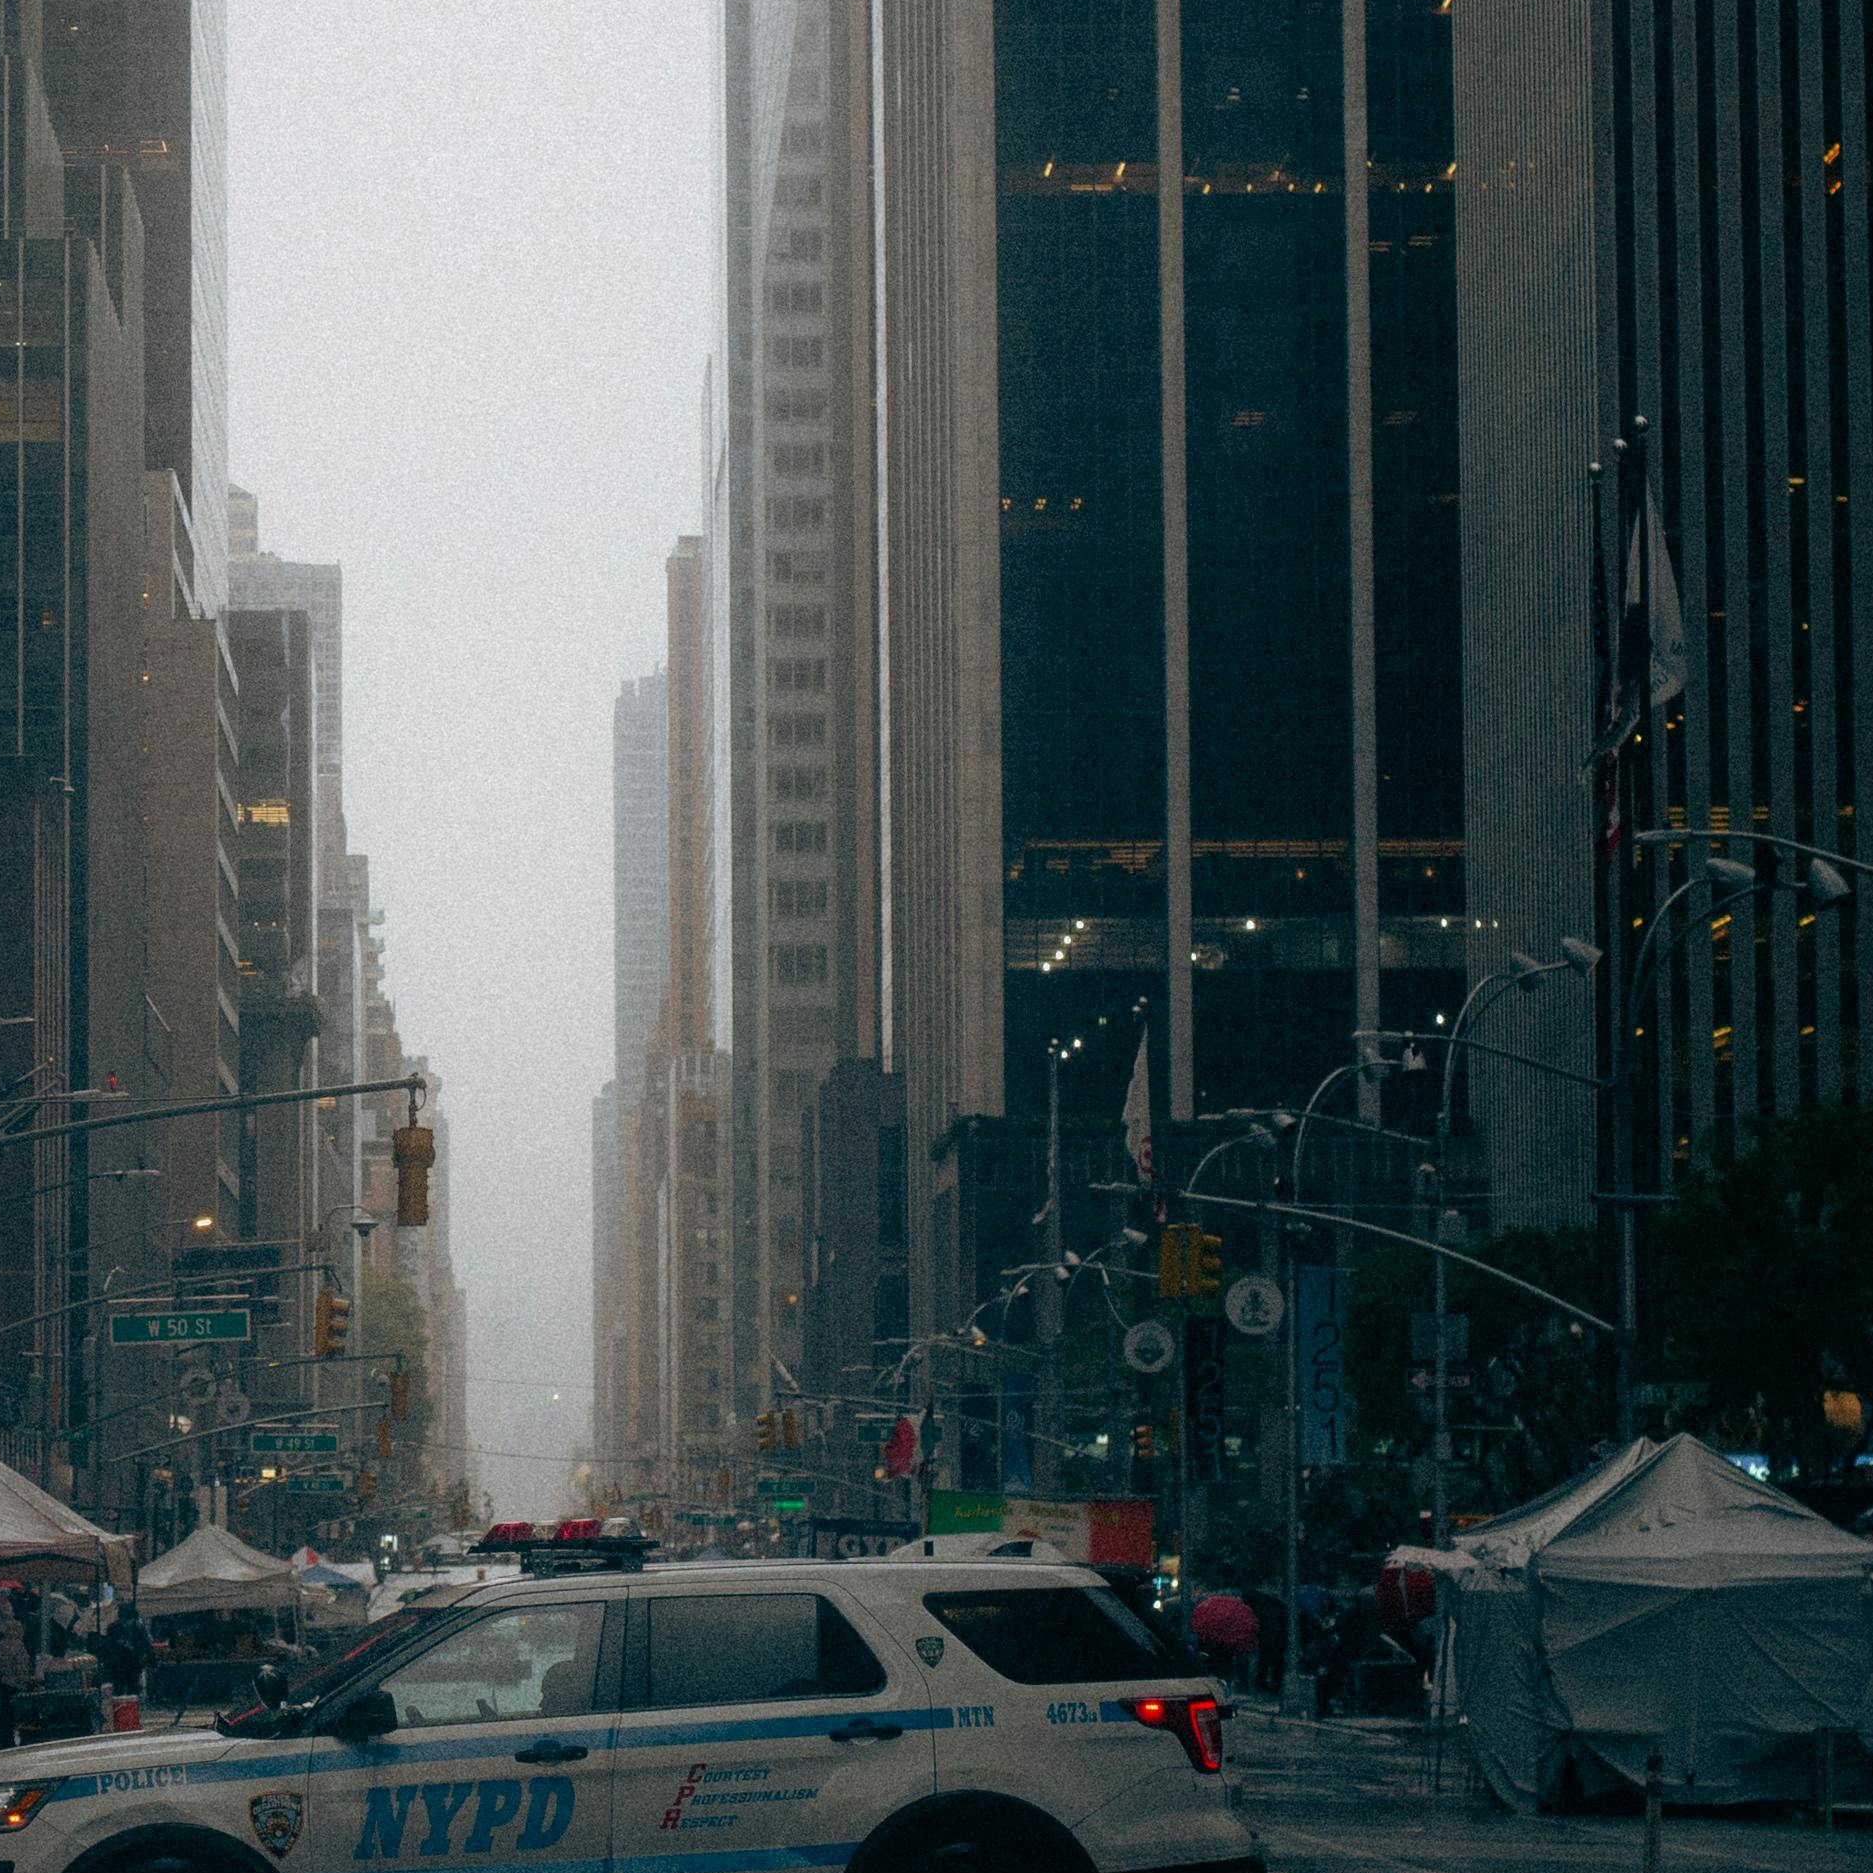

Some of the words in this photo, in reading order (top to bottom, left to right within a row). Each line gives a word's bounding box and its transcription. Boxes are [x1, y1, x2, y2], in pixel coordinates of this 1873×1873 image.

[148, 1320, 161, 1337] W
[167, 1320, 188, 1336] 50
[195, 1318, 212, 1335] St
[1312, 1274, 1341, 1459] 1251
[956, 1706, 995, 1728] MTN
[1046, 1702, 1088, 1725] 4673
[100, 1765, 185, 1794] POLICE
[688, 1763, 772, 1784] COURTESY
[672, 1785, 820, 1806] PROFESSIONALISM
[353, 1775, 576, 1860] NYPD
[659, 1808, 738, 1830] RESPECT
